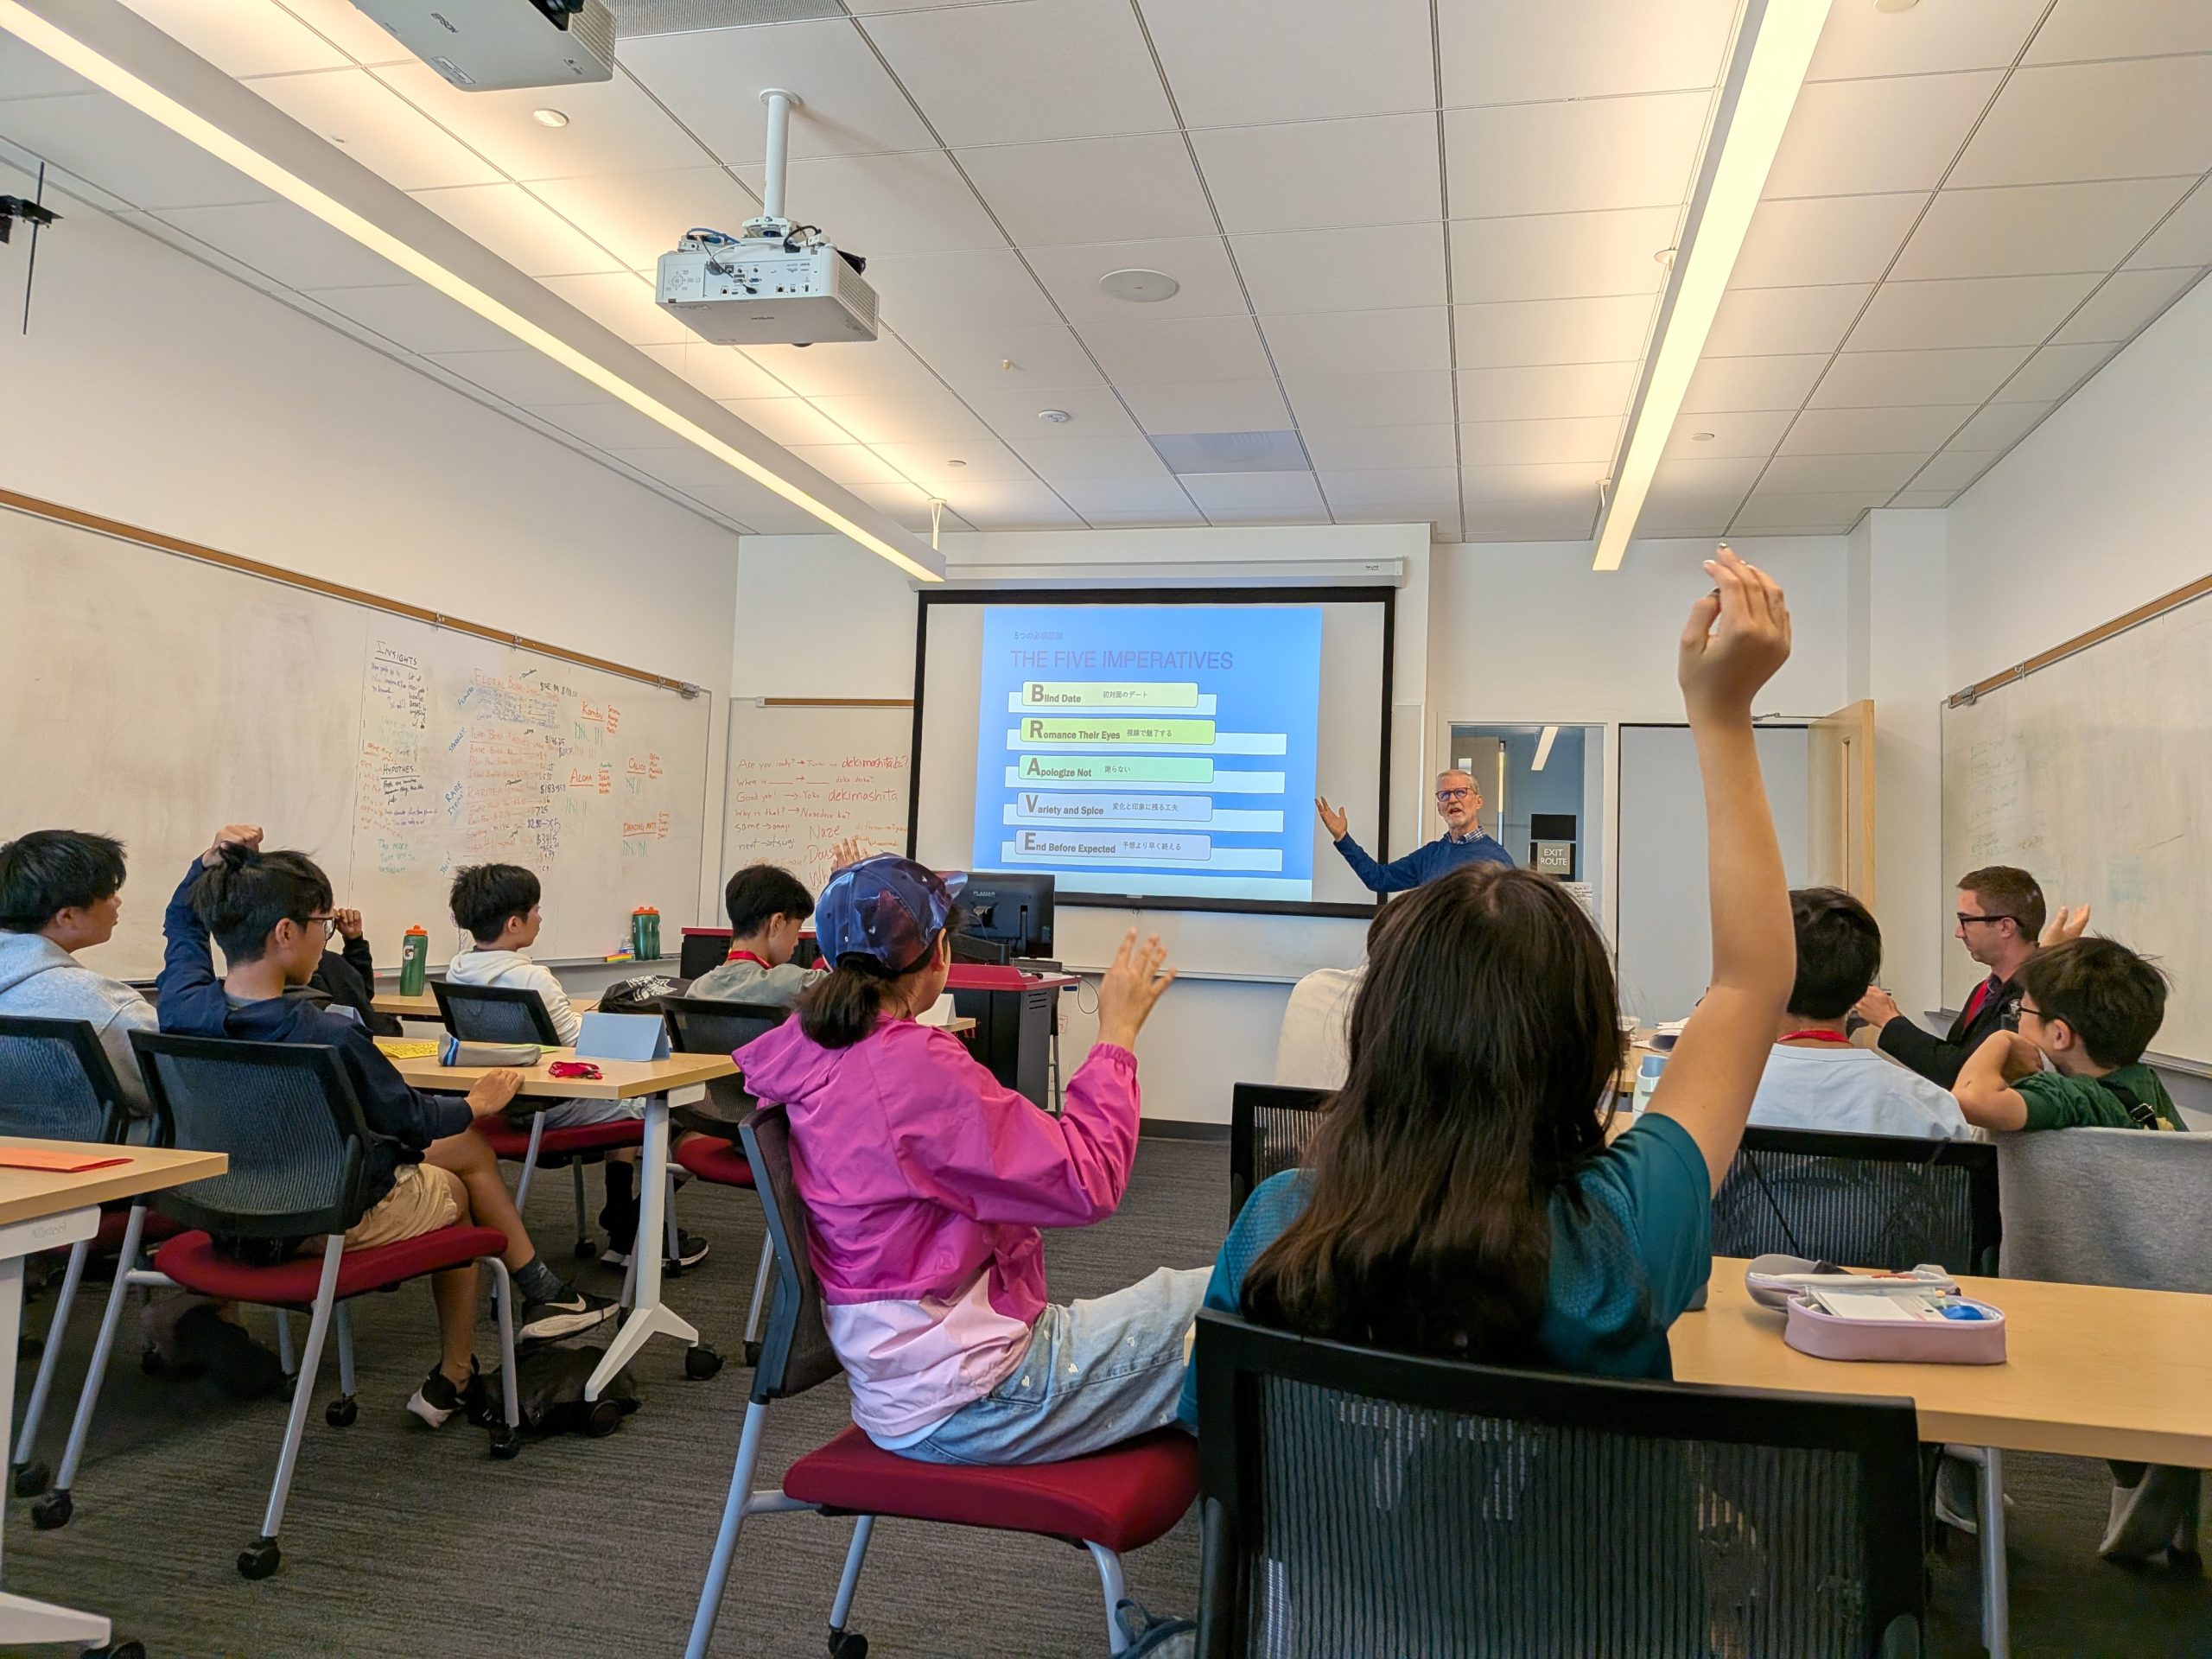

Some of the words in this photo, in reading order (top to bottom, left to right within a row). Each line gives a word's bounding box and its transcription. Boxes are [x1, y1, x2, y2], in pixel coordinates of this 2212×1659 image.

[376, 640, 417, 665] INSIGHTS
[1010, 651, 1049, 669] THE
[1054, 651, 1096, 669] FIVE
[1103, 651, 1234, 670] IMPERATIVES
[1031, 684, 1059, 702] Blind
[1061, 694, 1081, 703] Date
[1103, 690, 1148, 699] 初対面のデート
[1029, 720, 1077, 740] Romance
[1078, 730, 1100, 740] Their
[1102, 730, 1121, 741] Eyes
[1127, 729, 1173, 738] 視線で魅了する
[737, 759, 755, 770] Are
[760, 761, 772, 770] you
[1027, 758, 1076, 778] Apologize
[1077, 768, 1091, 777] Not
[736, 791, 759, 802] Good
[803, 790, 820, 799] Yoku
[828, 788, 898, 802] dekimashita
[1025, 794, 1062, 815] Variety
[1064, 805, 1079, 815] and
[1081, 806, 1104, 816] Spice
[734, 810, 751, 818] Why
[734, 823, 760, 831] same
[809, 824, 841, 841] Naze
[739, 837, 760, 850] next
[770, 834, 795, 849] tsugi
[1024, 832, 1046, 851] End
[1048, 842, 1076, 853] Before
[1077, 844, 1116, 854] Expected
[1122, 841, 1182, 850] 予想より早く終える
[1540, 857, 1568, 866] ROUTE
